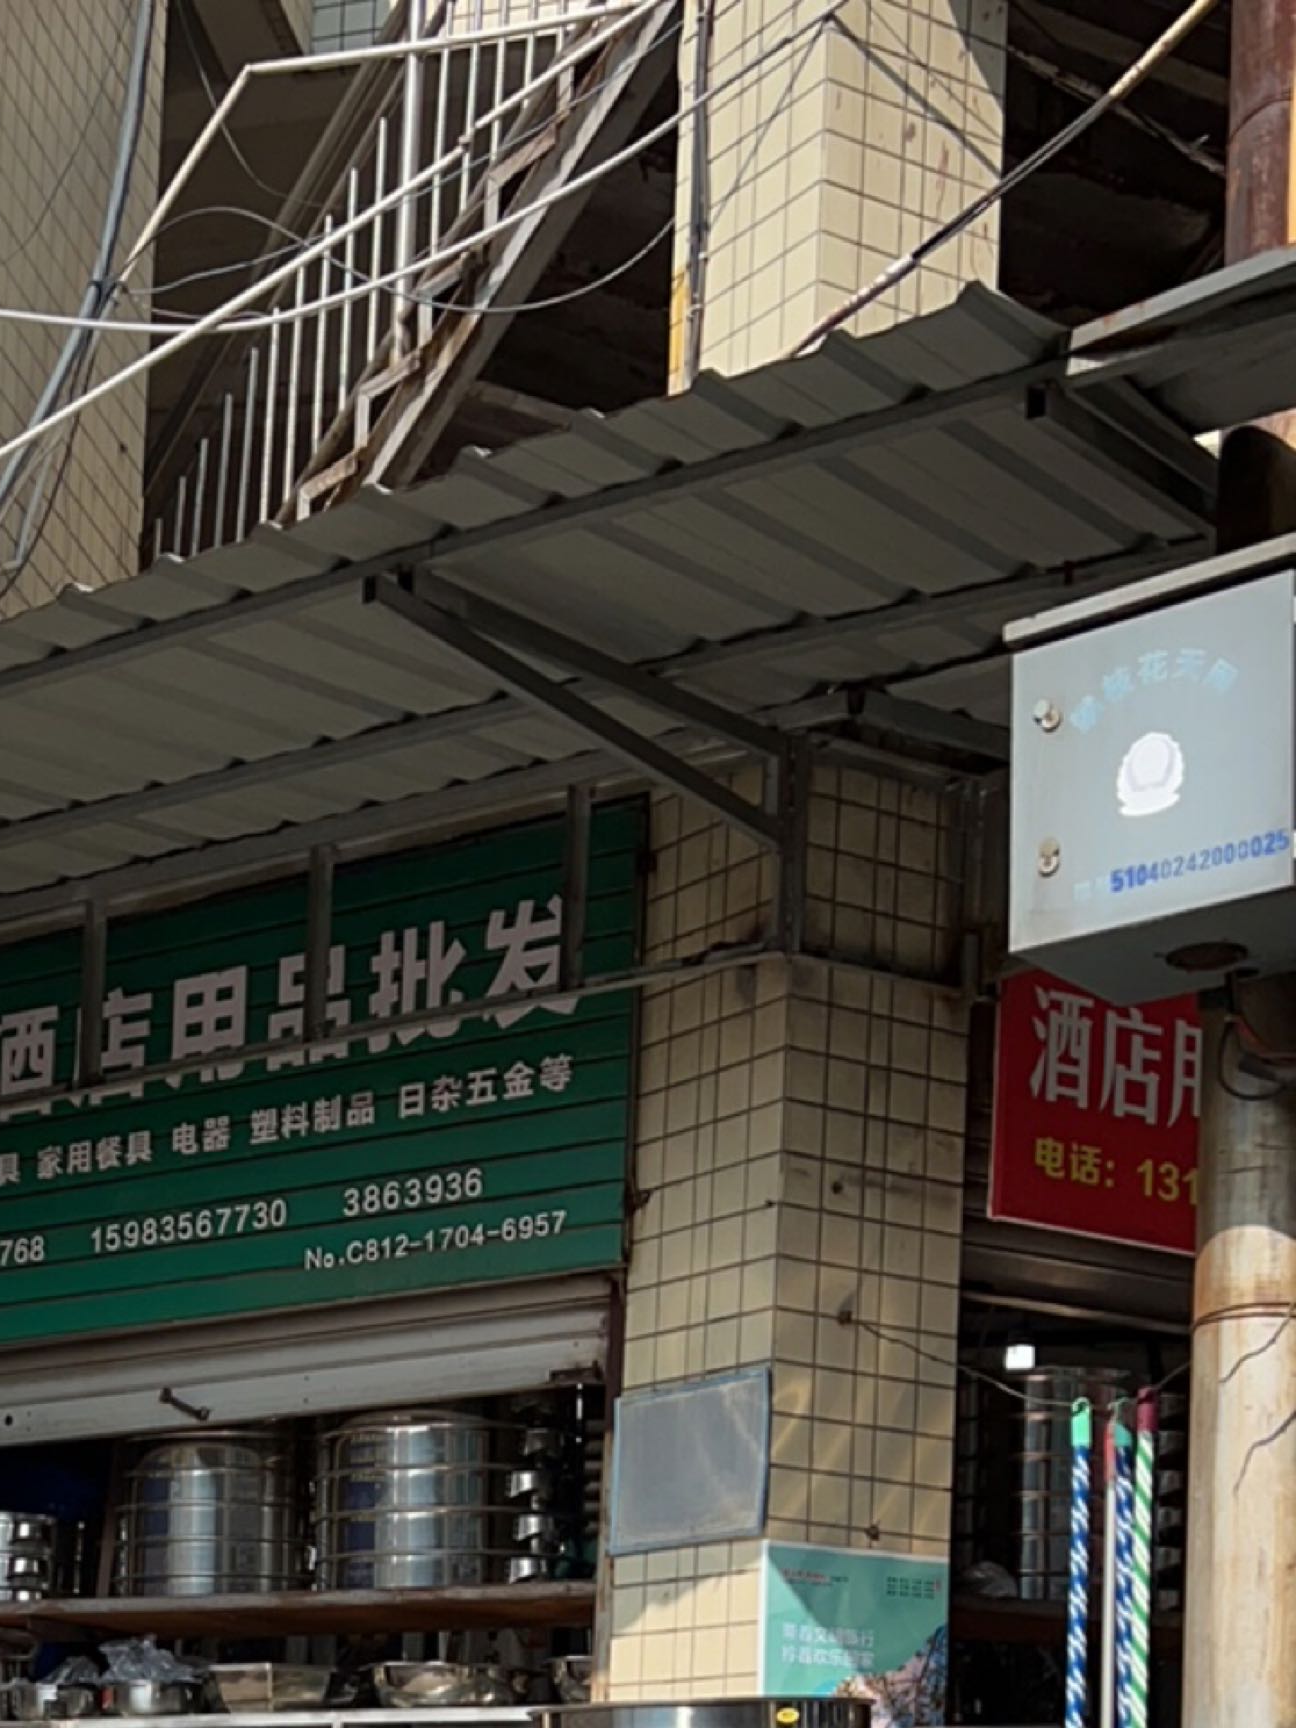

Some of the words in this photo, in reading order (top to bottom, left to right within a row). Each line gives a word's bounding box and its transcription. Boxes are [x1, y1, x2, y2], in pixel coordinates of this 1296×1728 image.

[35, 1130, 153, 1181] 家用餐具
[170, 1115, 232, 1156] 电器
[248, 1090, 377, 1147] 塑料制品
[397, 1053, 576, 1119] 日杂五金等
[89, 1199, 289, 1254] 15983567730
[342, 1167, 485, 1218] 3863936
